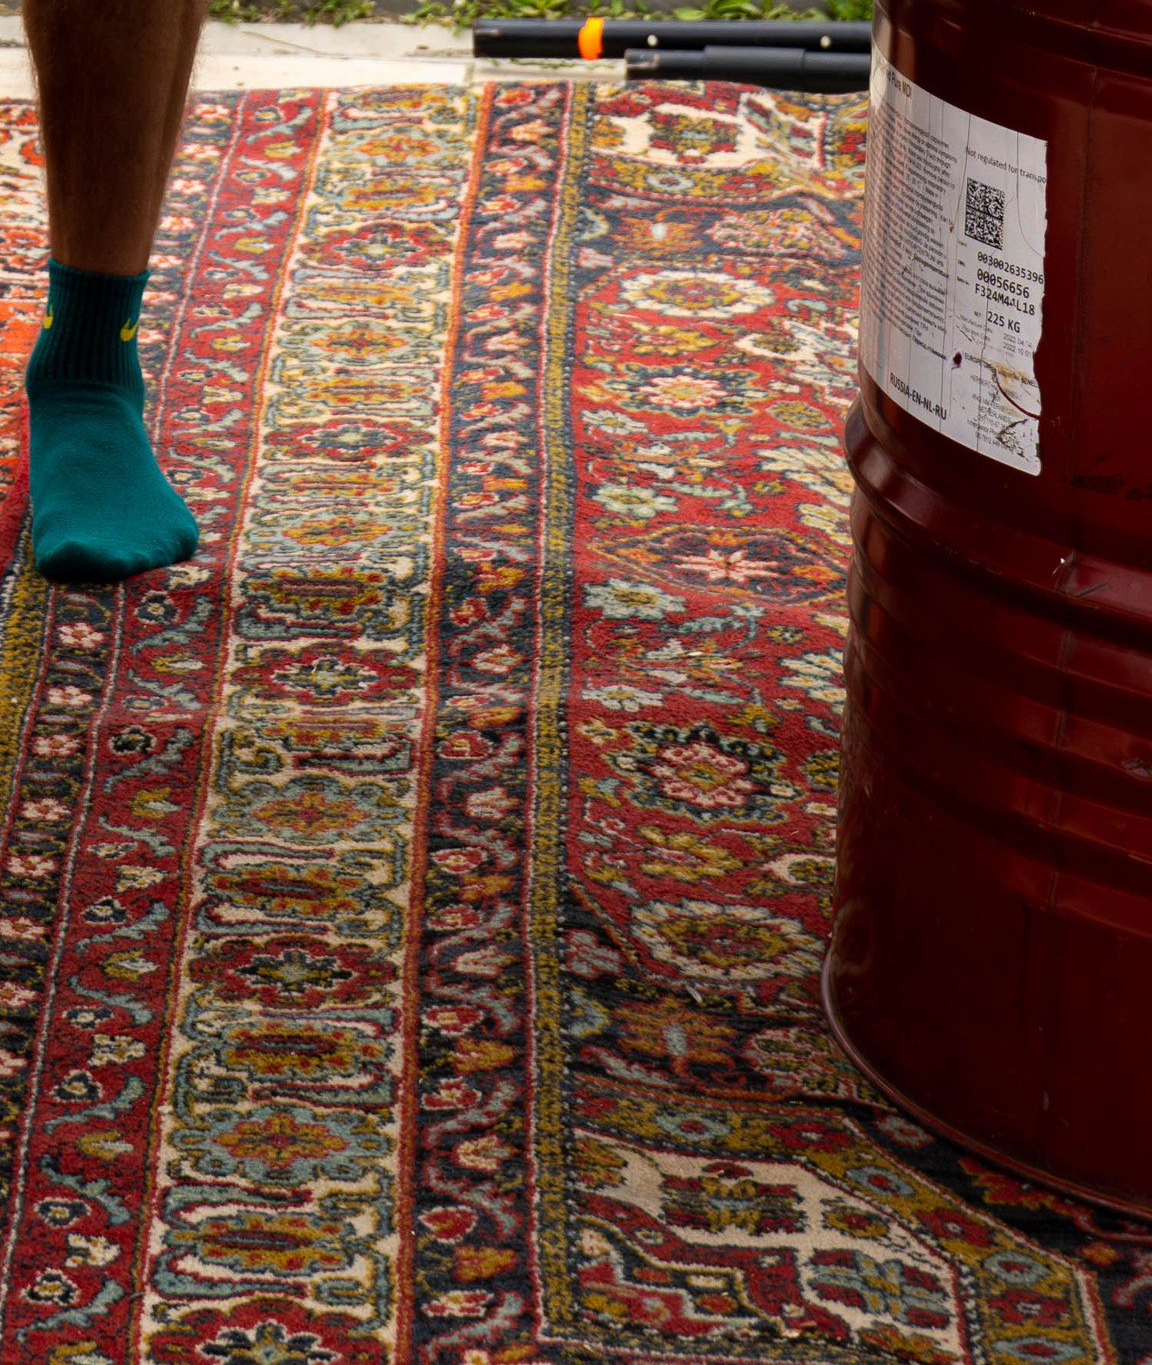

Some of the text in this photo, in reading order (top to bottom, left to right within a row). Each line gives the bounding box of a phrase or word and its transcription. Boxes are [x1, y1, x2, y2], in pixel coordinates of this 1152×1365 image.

[978, 153, 1007, 170] regulated
[977, 251, 1044, 285] 003002635396
[977, 268, 1030, 299] 00056656
[988, 311, 1005, 327] 225
[1008, 319, 1021, 333] KG
[890, 372, 947, 420] RUSSIA-EN-NL-RU
